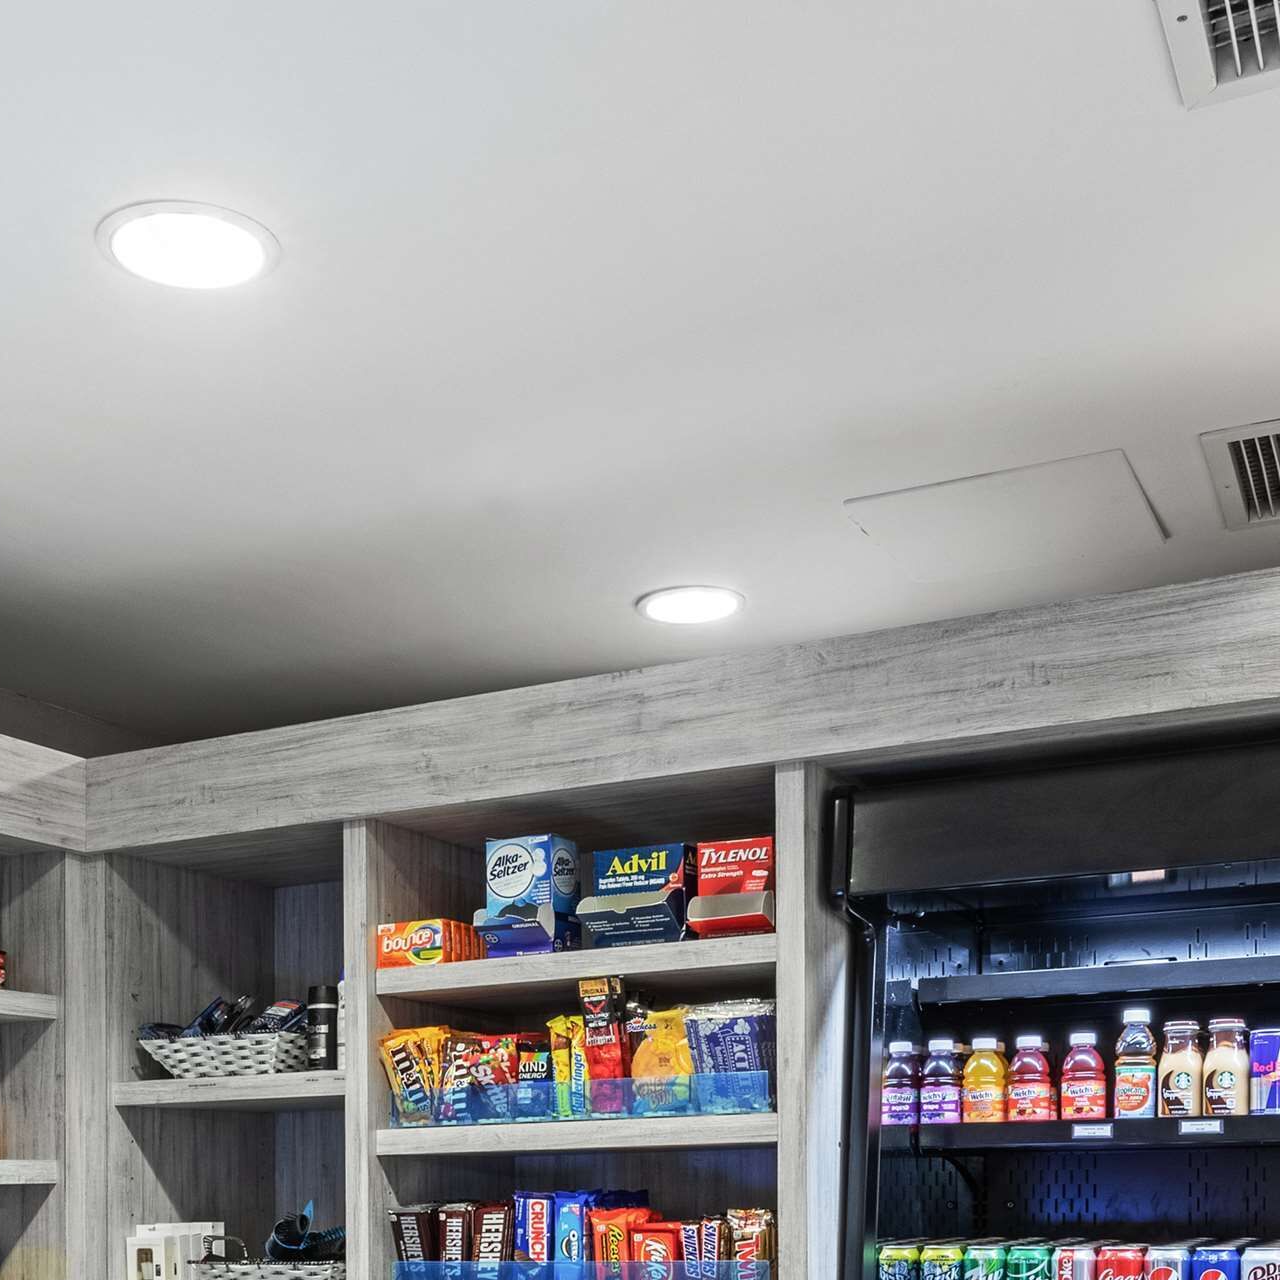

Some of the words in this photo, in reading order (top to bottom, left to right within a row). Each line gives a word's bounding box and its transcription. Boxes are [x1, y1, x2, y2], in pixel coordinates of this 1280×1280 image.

[493, 853, 522, 869] Alka-
[606, 850, 669, 876] Advil
[700, 847, 768, 866] TYLENOL
[489, 860, 529, 881] Seltzer
[383, 928, 433, 952] bounce
[519, 1062, 547, 1072] KIND
[1253, 1062, 1273, 1073] Red
[399, 1216, 426, 1272] HERSHEY'S
[529, 1200, 547, 1264] CRUNCH
[445, 1218, 463, 1276] HERSHEY'S
[569, 1230, 578, 1262] OREO
[683, 1225, 702, 1279] SNICKERS
[702, 1223, 718, 1278] SNICKERS
